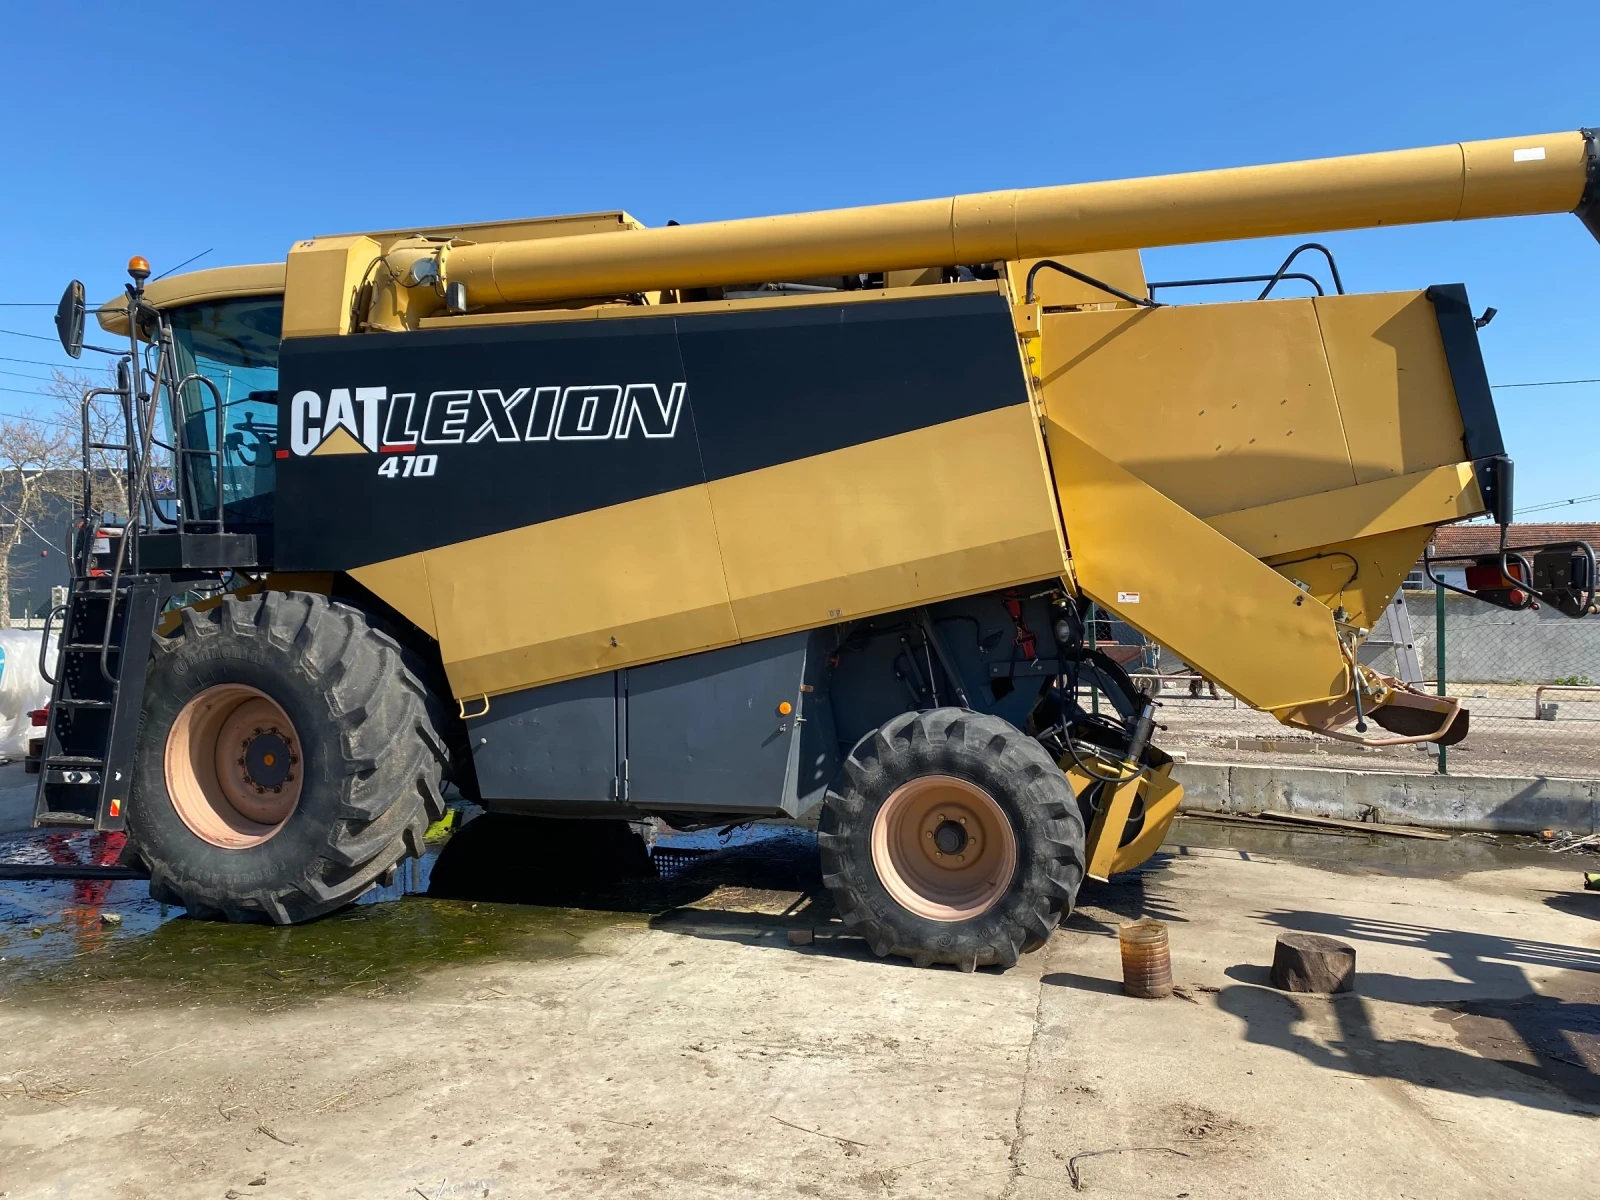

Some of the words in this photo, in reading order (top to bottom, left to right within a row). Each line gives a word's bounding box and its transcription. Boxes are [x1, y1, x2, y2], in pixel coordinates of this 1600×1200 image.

[291, 386, 387, 456] CAT
[382, 382, 687, 446] LEXION
[378, 454, 439, 478] 470
